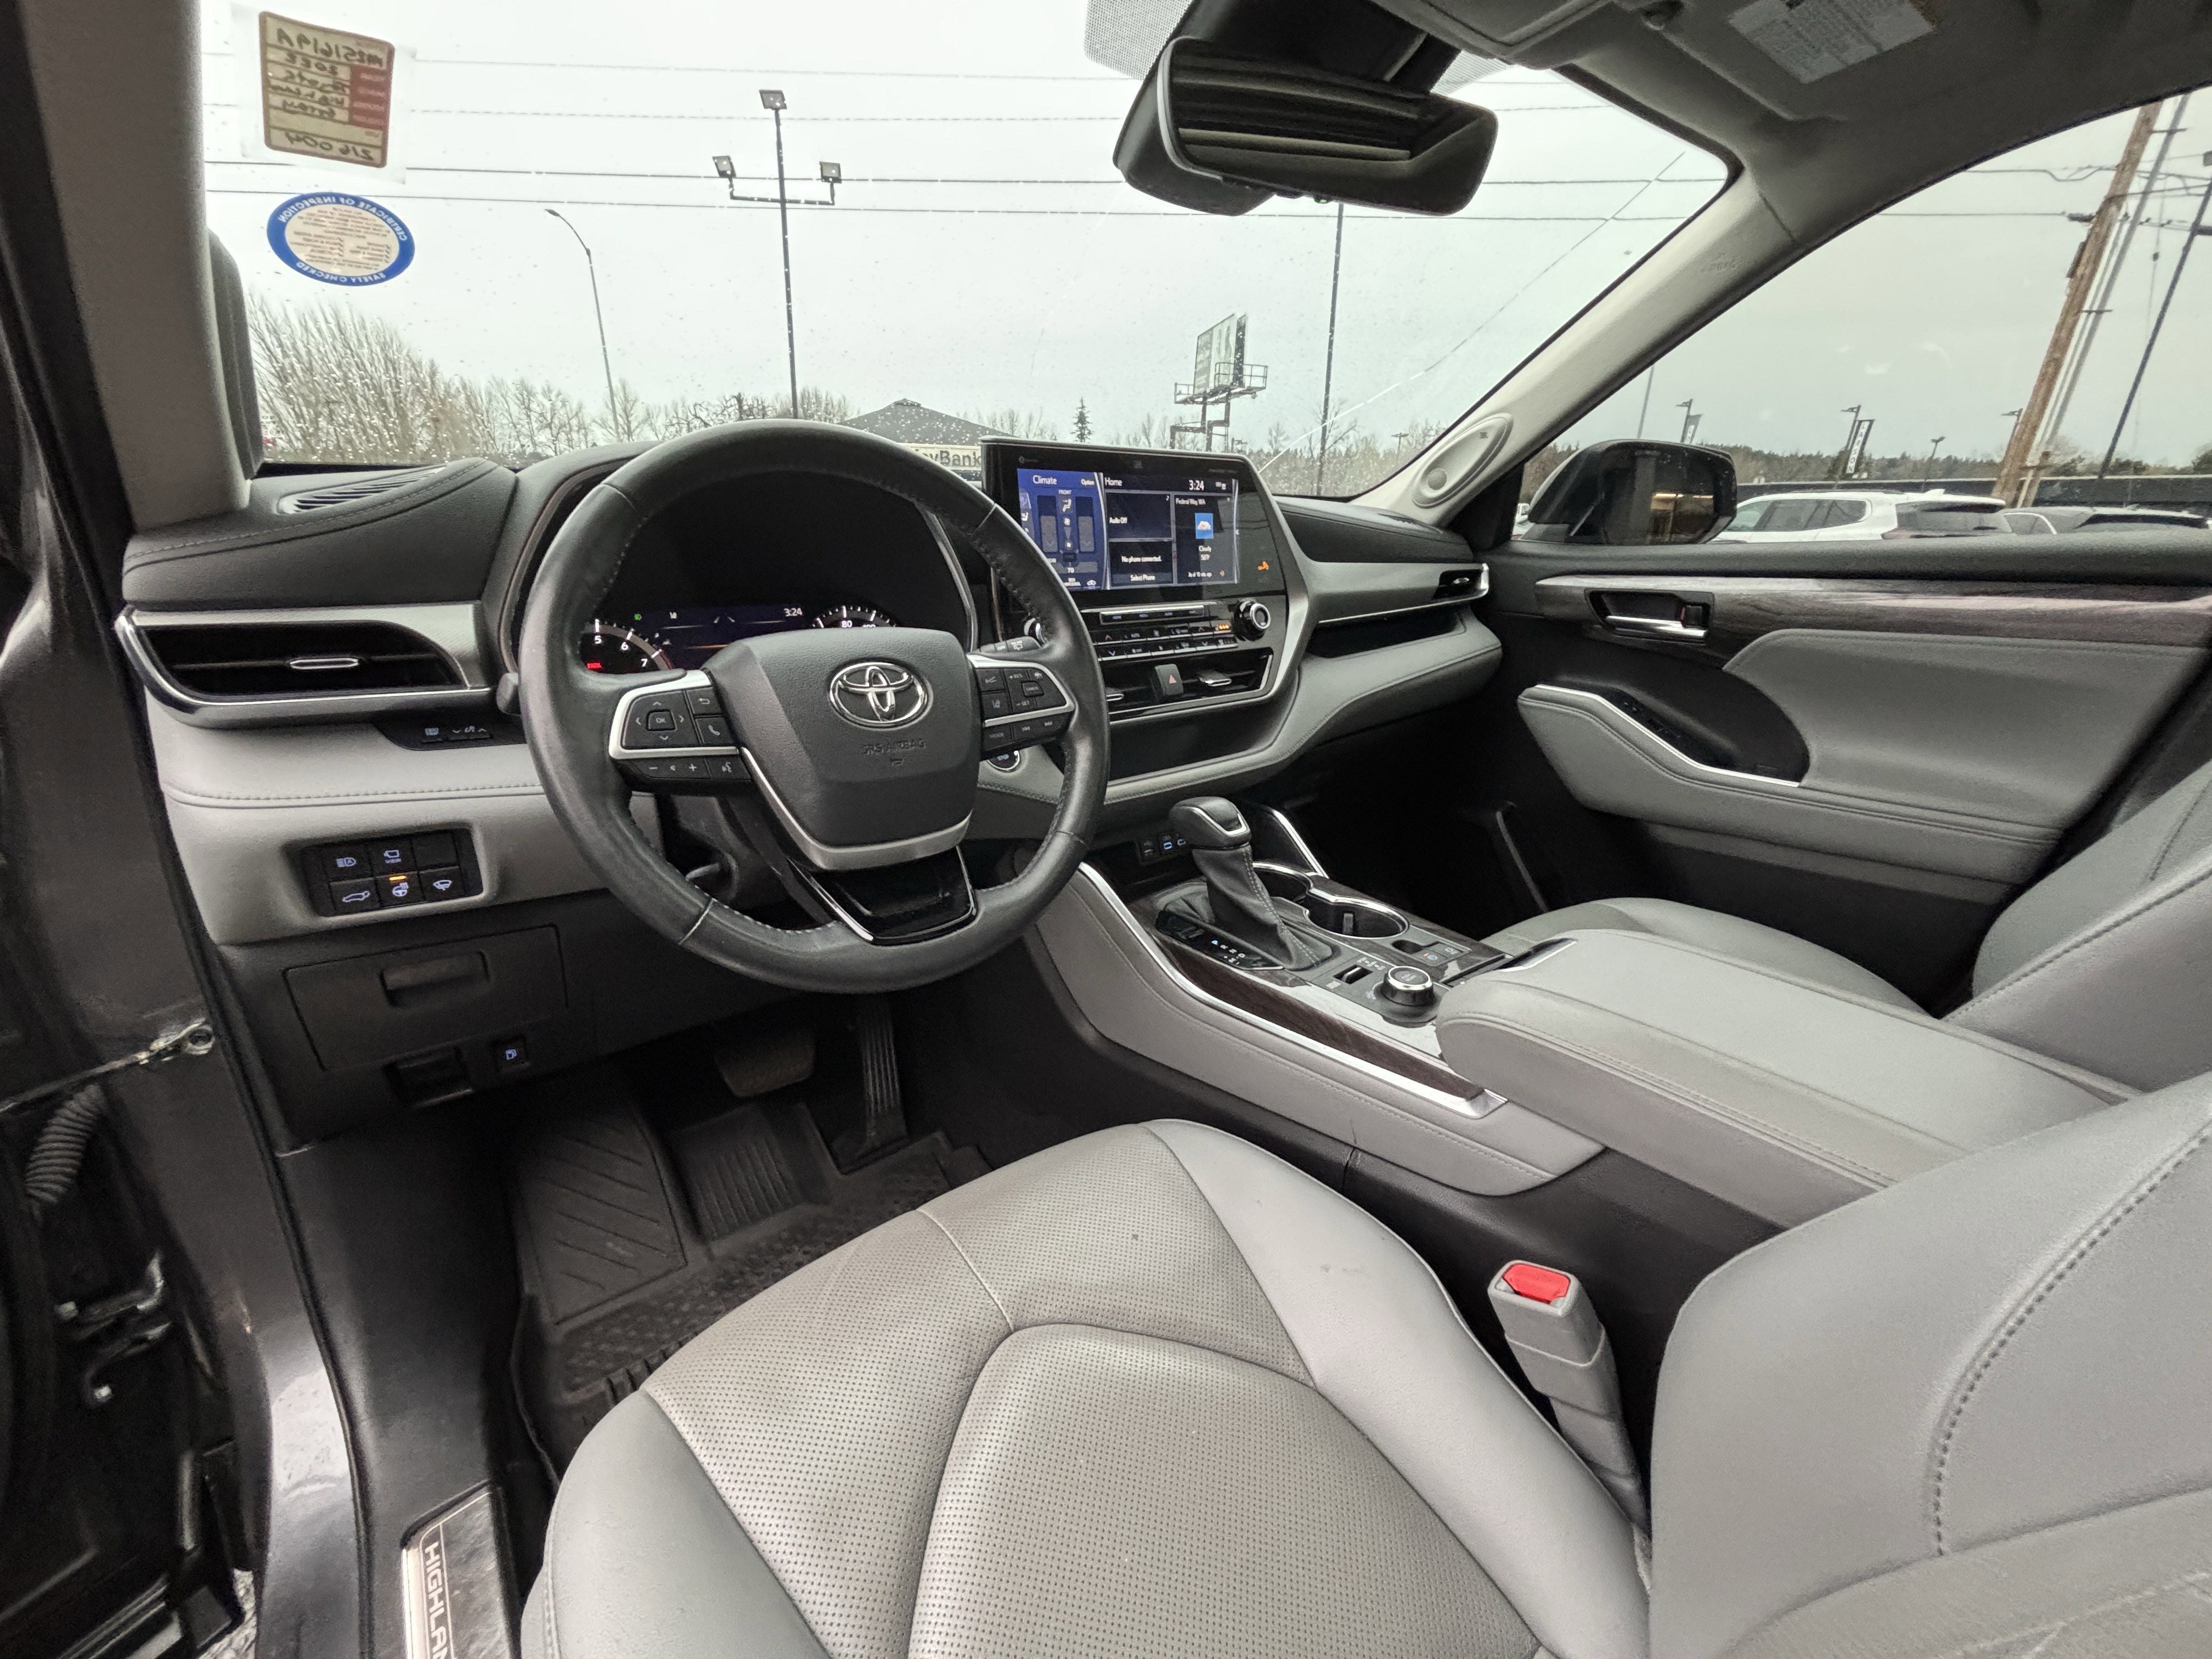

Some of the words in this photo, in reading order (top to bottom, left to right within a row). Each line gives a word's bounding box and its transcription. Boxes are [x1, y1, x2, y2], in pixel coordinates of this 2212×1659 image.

[1848, 423, 1866, 472] LARSON
[1032, 475, 1057, 484] Climate
[1104, 477, 1122, 487] Home
[1188, 479, 1205, 490] 3:24
[1128, 555, 1141, 563] phone
[783, 607, 803, 617] 3:24
[594, 635, 602, 644] 5
[620, 642, 629, 651] 6
[641, 658, 648, 667] 7
